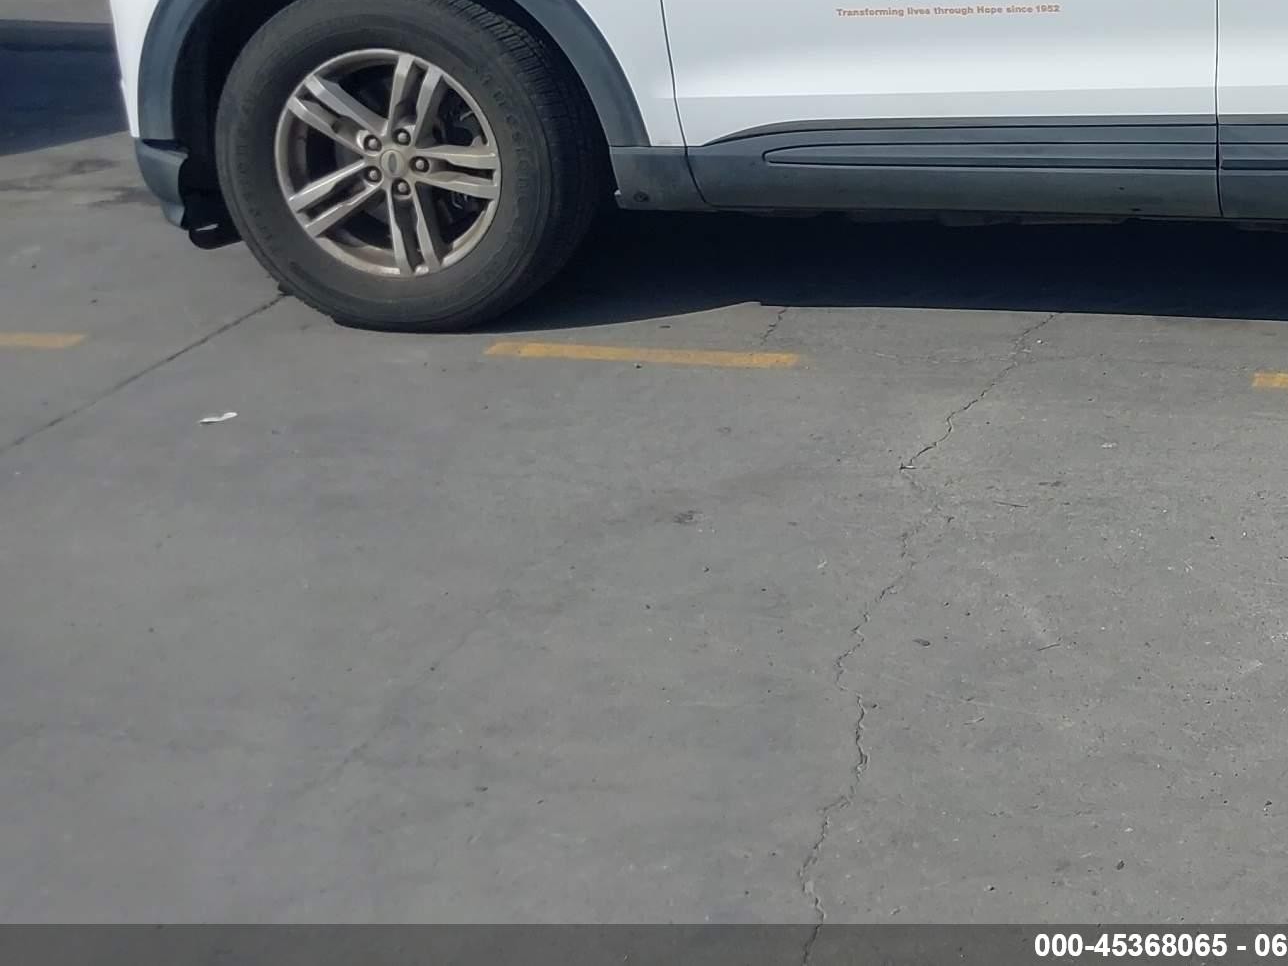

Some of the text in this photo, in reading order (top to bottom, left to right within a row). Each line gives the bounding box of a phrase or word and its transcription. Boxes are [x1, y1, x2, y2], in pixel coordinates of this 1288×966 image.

[836, 3, 1060, 17] Transforming lives through Hope since 1952
